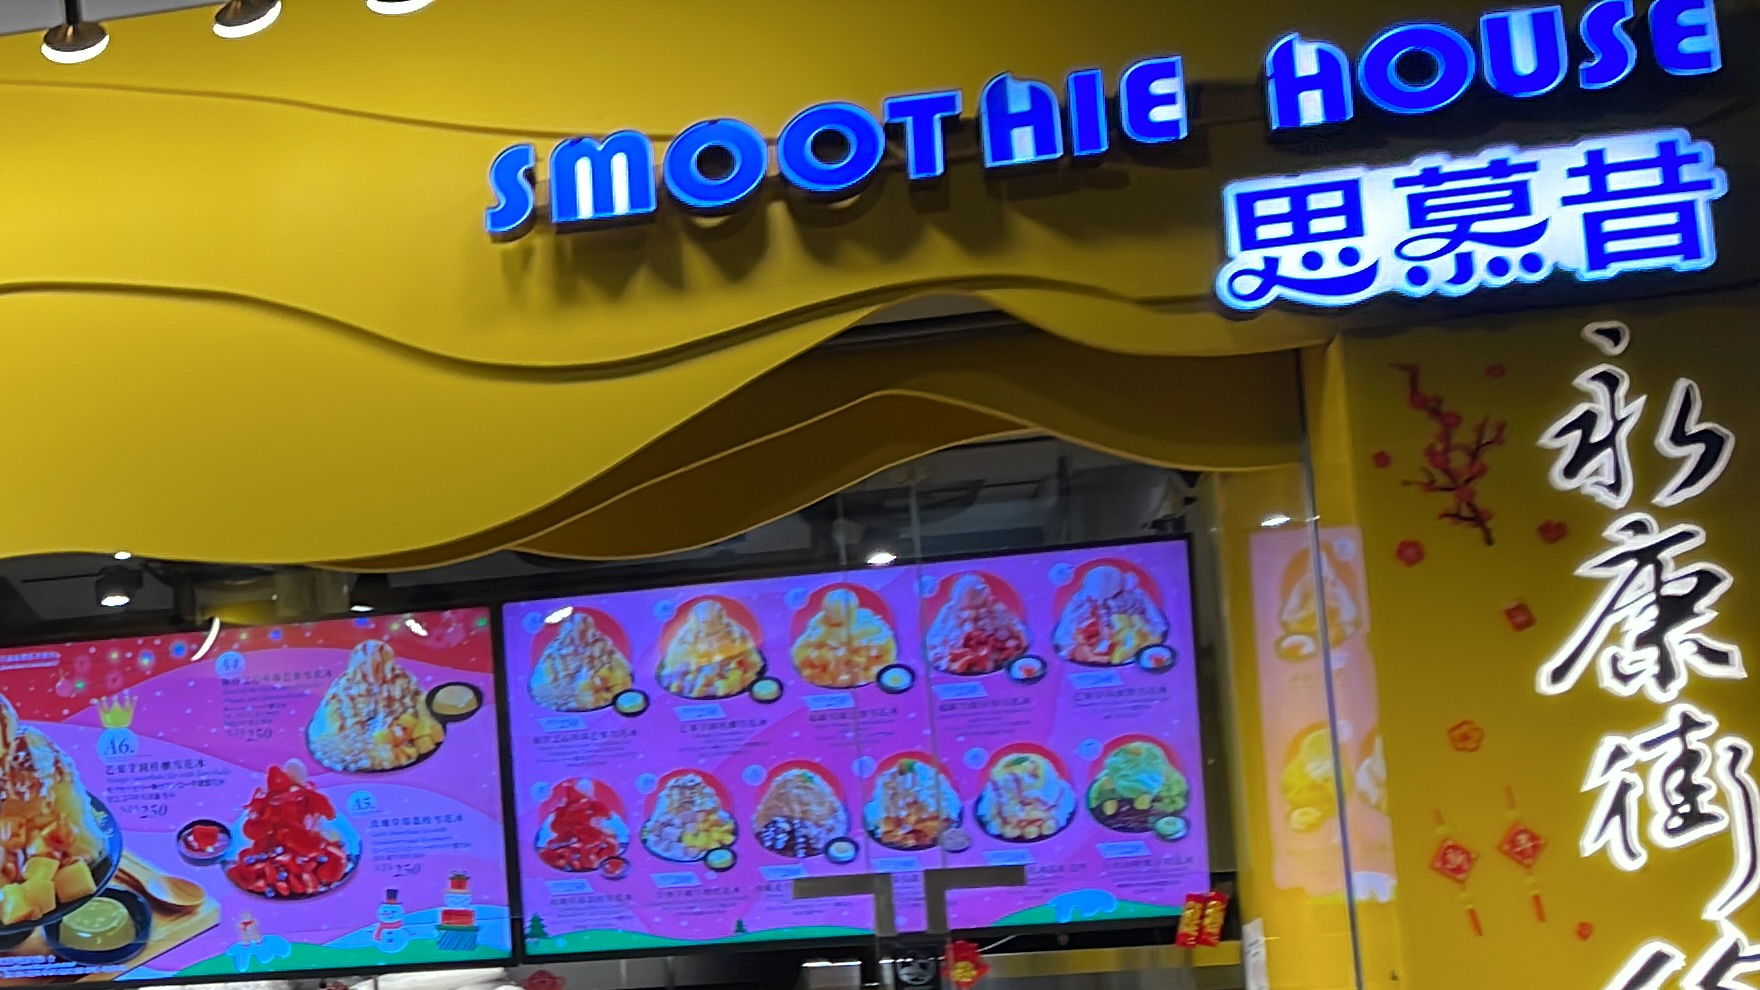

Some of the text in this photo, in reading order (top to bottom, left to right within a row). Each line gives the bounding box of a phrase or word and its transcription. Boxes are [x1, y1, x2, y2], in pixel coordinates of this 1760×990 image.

[484, 0, 1723, 240] SMOOTHIE HOUSE
[1213, 126, 1729, 316] 思慕昔
